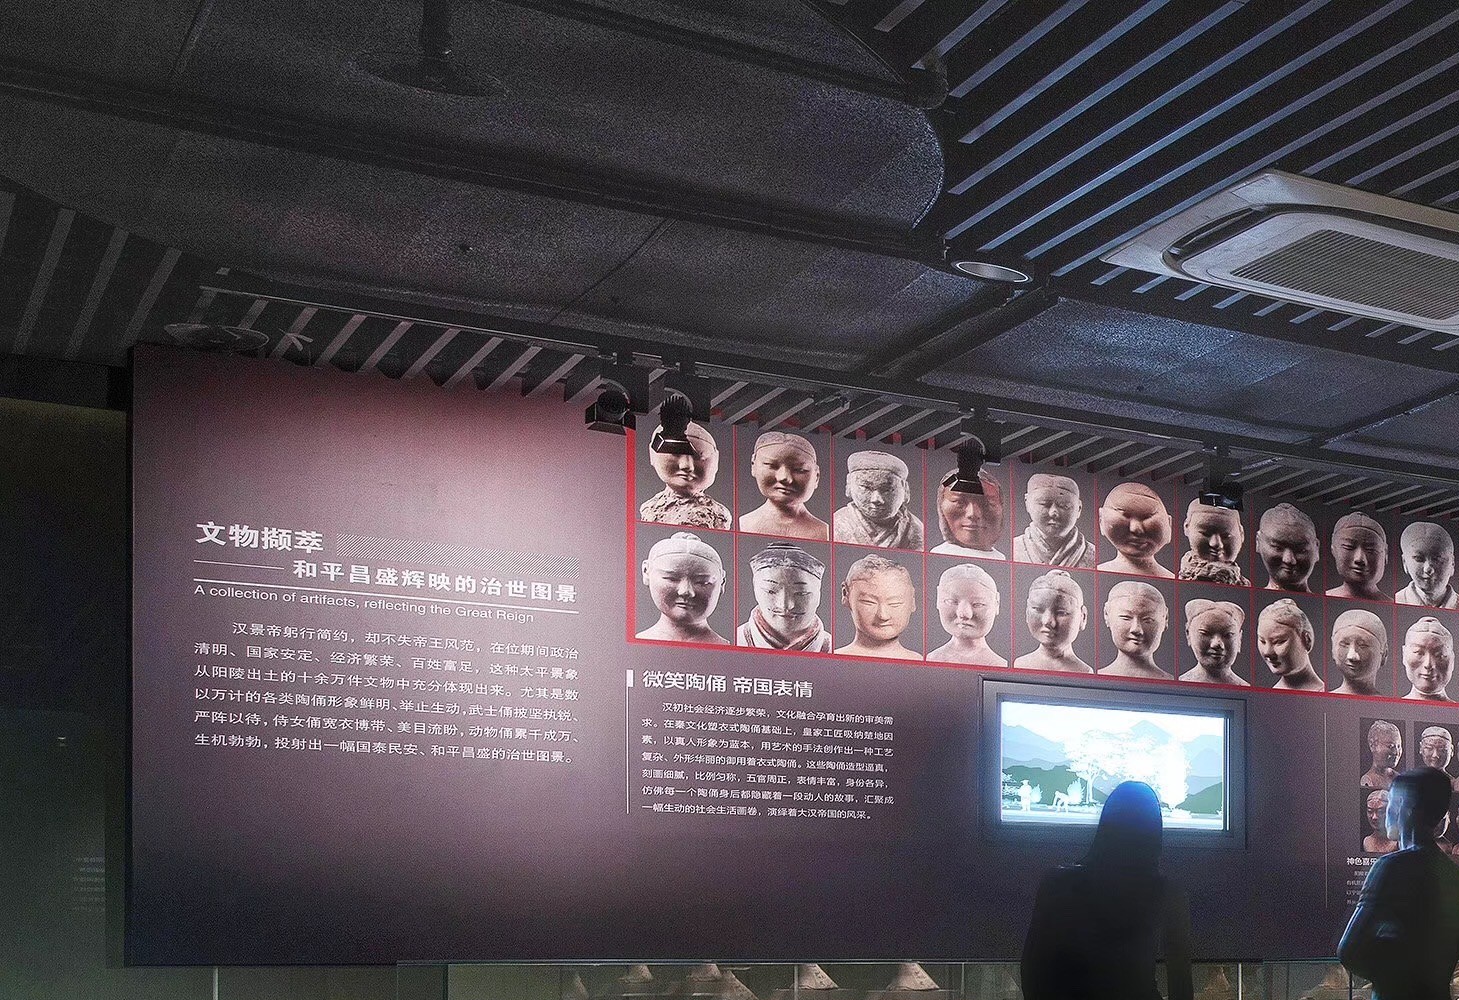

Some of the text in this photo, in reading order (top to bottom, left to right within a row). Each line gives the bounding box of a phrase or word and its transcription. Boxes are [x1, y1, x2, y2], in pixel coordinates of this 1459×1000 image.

[196, 521, 323, 553] 文物撷萃
[293, 560, 577, 603] 和平昌盛辉映的治世图景
[194, 585, 534, 623] A collection of artifacts, reflecting the Great Reign
[642, 669, 814, 698] 微笑陶俑 帝国表情
